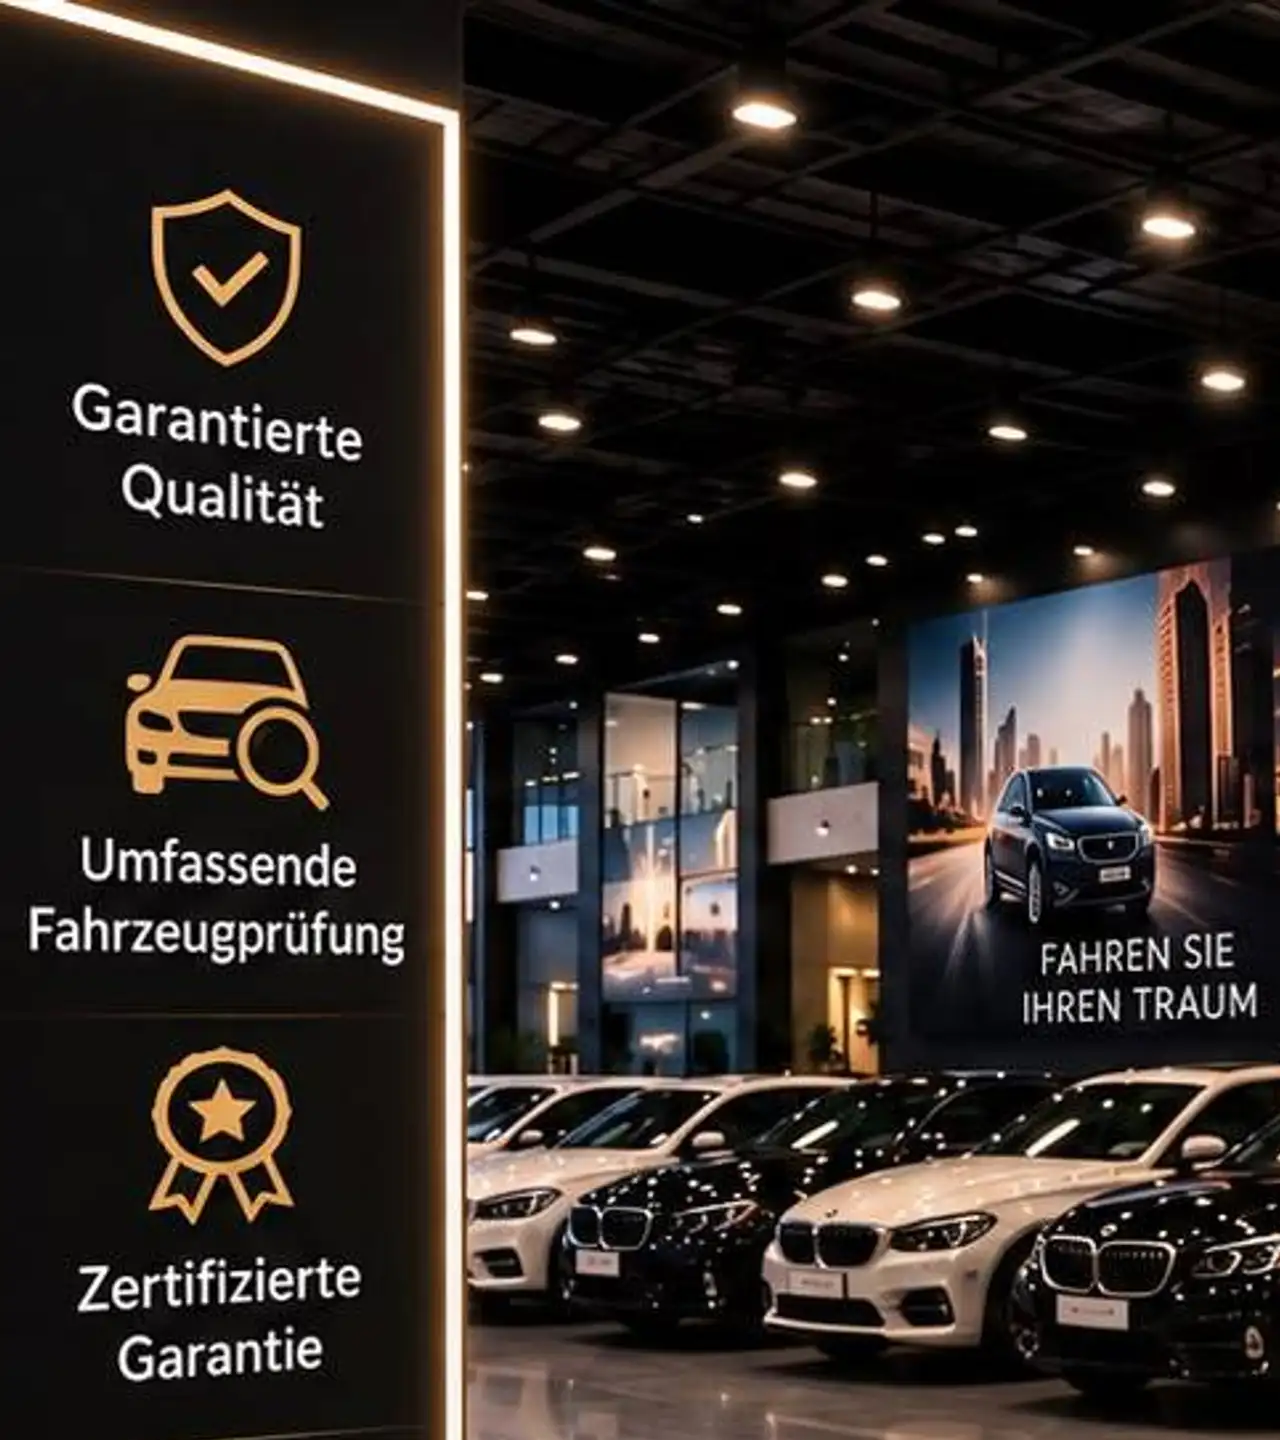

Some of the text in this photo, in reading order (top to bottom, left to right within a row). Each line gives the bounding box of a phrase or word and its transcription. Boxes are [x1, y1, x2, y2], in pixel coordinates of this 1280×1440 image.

[72, 384, 363, 462] Garantierte
[121, 463, 324, 529] Qualität
[82, 836, 357, 888] Umfassende
[29, 905, 405, 967] Fahrzeugprüfung
[1041, 932, 1235, 976] FAHREN SIE
[1023, 982, 1258, 1024] IHREN TRAUM
[77, 1256, 362, 1312] Zertifizierte
[118, 1325, 323, 1382] Garantie
